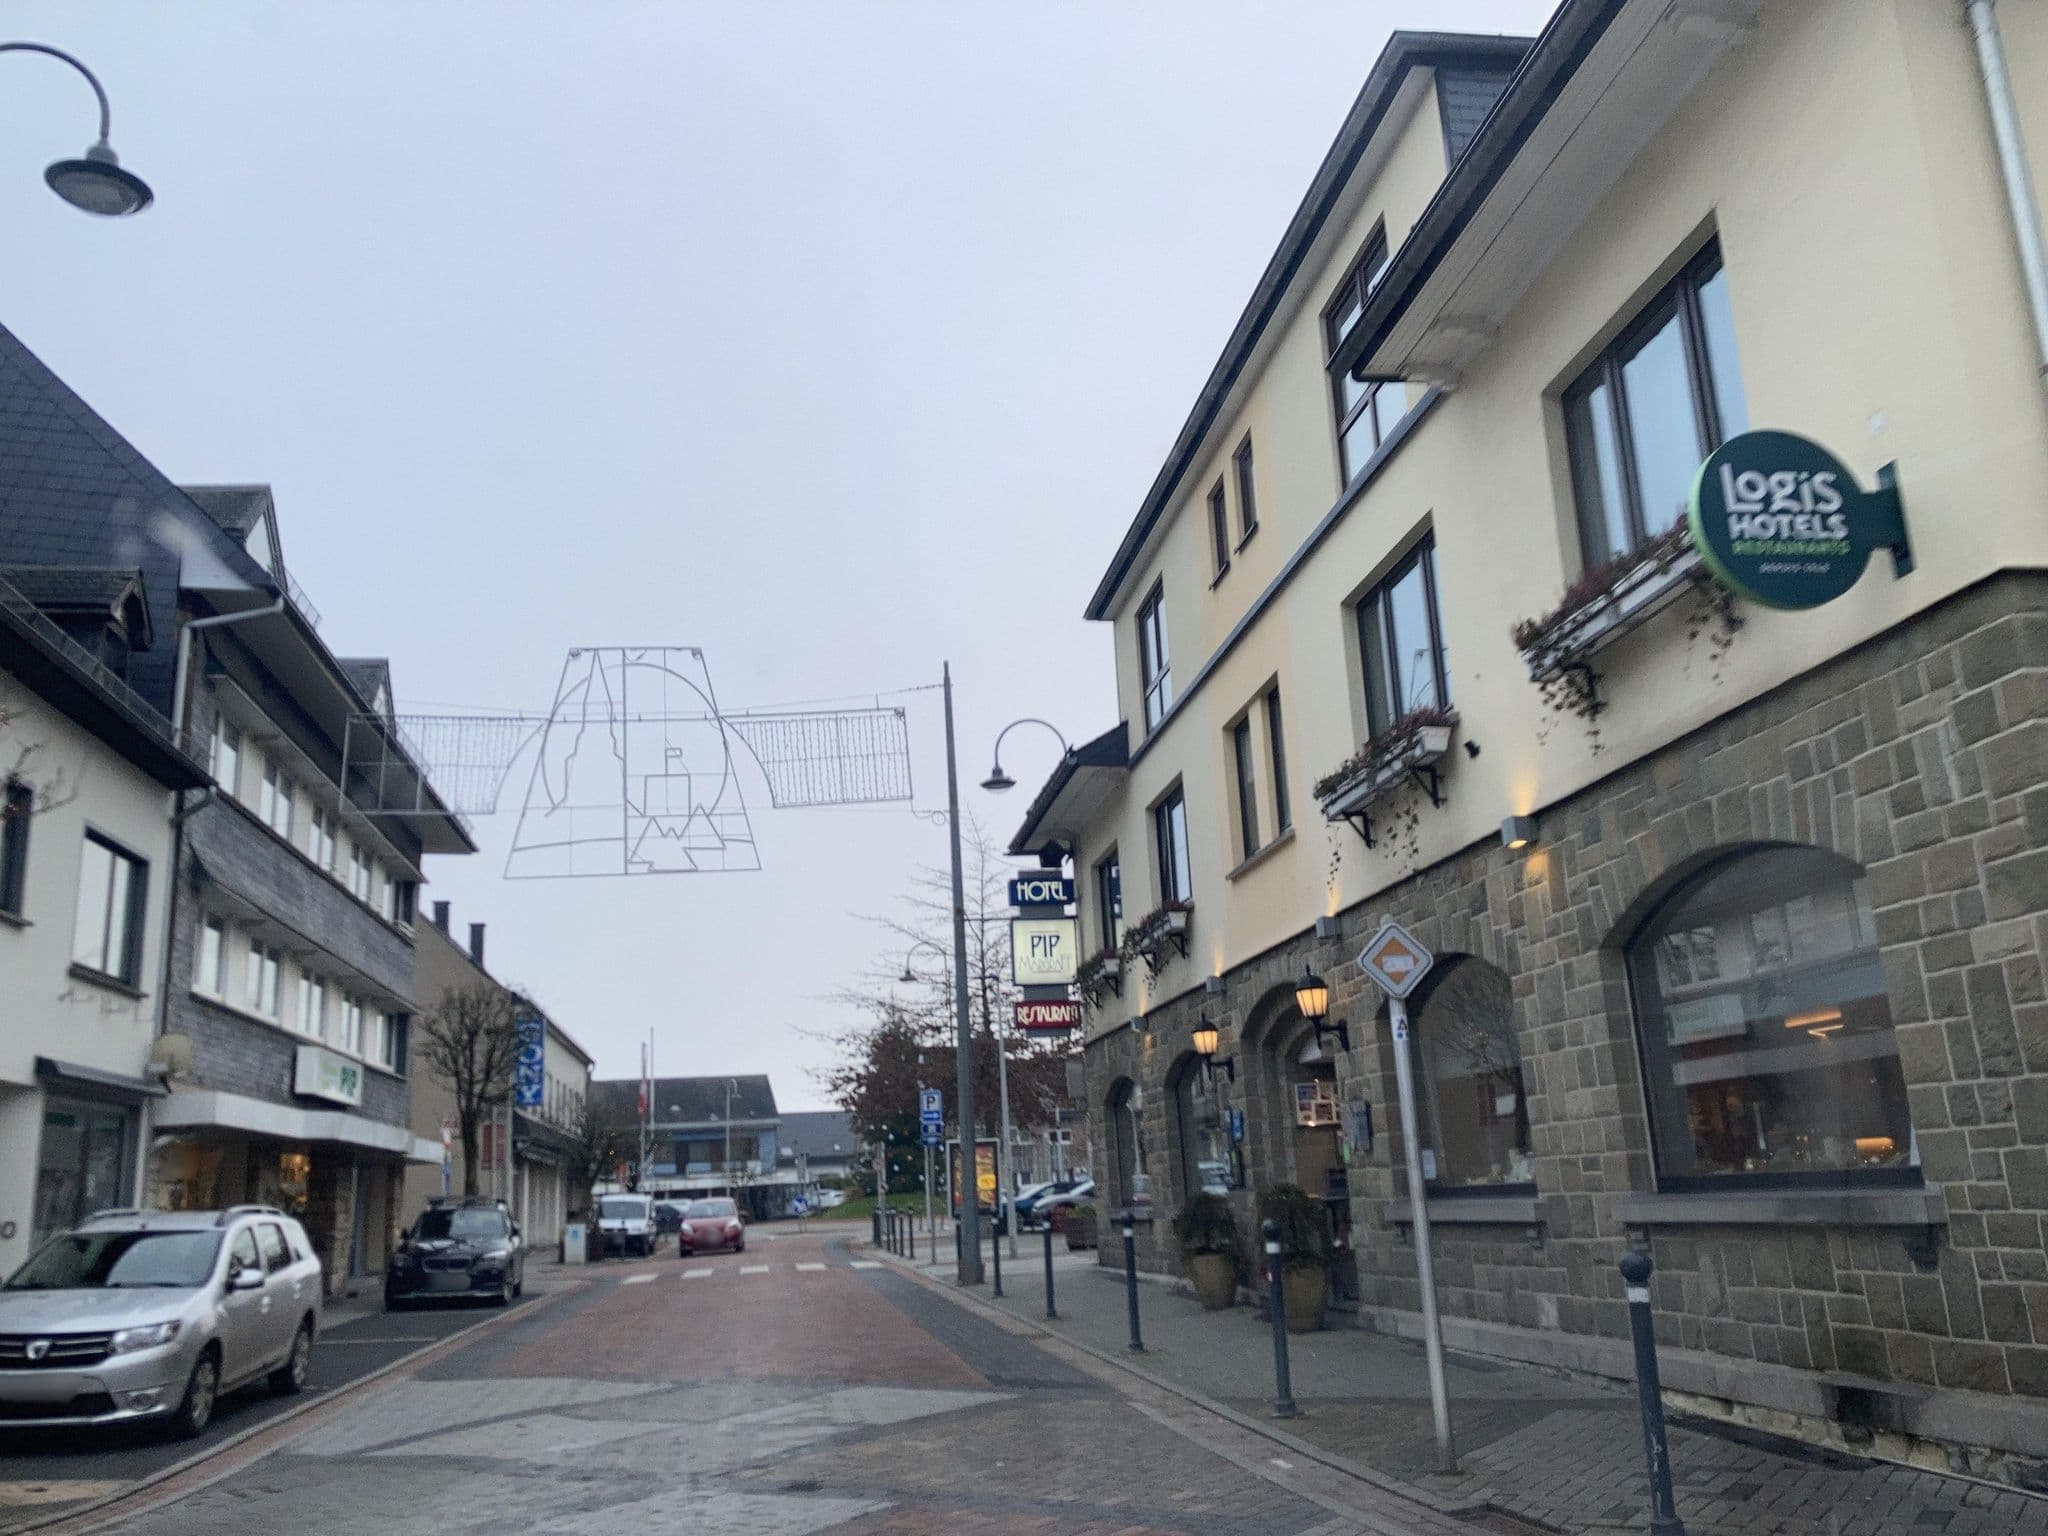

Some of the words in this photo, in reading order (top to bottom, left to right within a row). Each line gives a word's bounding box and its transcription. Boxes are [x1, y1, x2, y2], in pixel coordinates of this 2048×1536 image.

[1728, 512, 1849, 540] HOTELS
[1016, 880, 1067, 901] HOTEL
[1031, 935, 1060, 958] PIP
[518, 1022, 543, 1104] SONY
[926, 1096, 936, 1110] P
